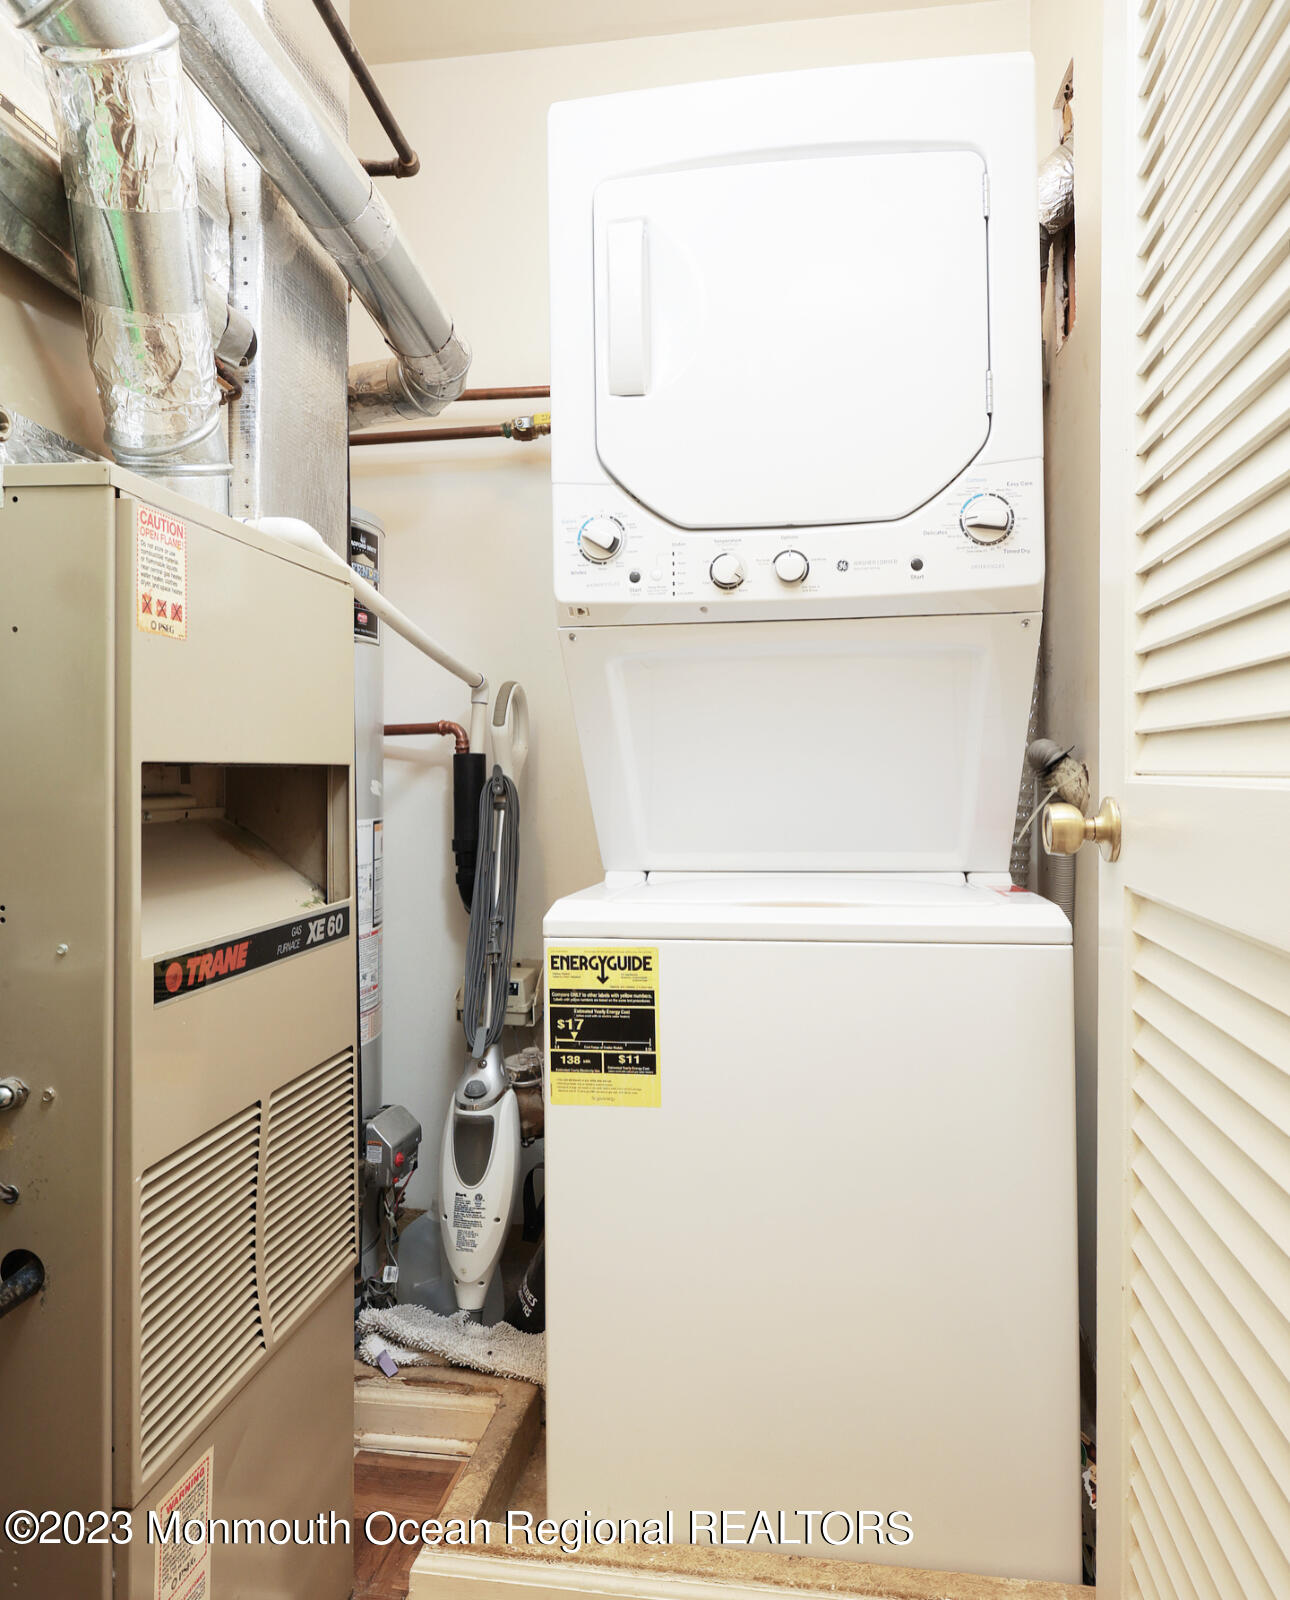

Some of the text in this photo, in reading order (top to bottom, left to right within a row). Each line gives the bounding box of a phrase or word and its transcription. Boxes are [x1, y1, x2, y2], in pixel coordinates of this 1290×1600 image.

[140, 510, 184, 539] CAUTION
[140, 526, 159, 541] OPEN
[291, 925, 303, 937] GAS
[306, 913, 343, 945] XE 60
[276, 938, 301, 956] FURNACE
[186, 941, 250, 987] TRANE
[550, 955, 653, 973] ENERGYGUIDE
[557, 1018, 584, 1030] $17
[560, 1055, 580, 1065] 138
[618, 1054, 640, 1065] $11
[166, 1467, 205, 1514] WARNING
